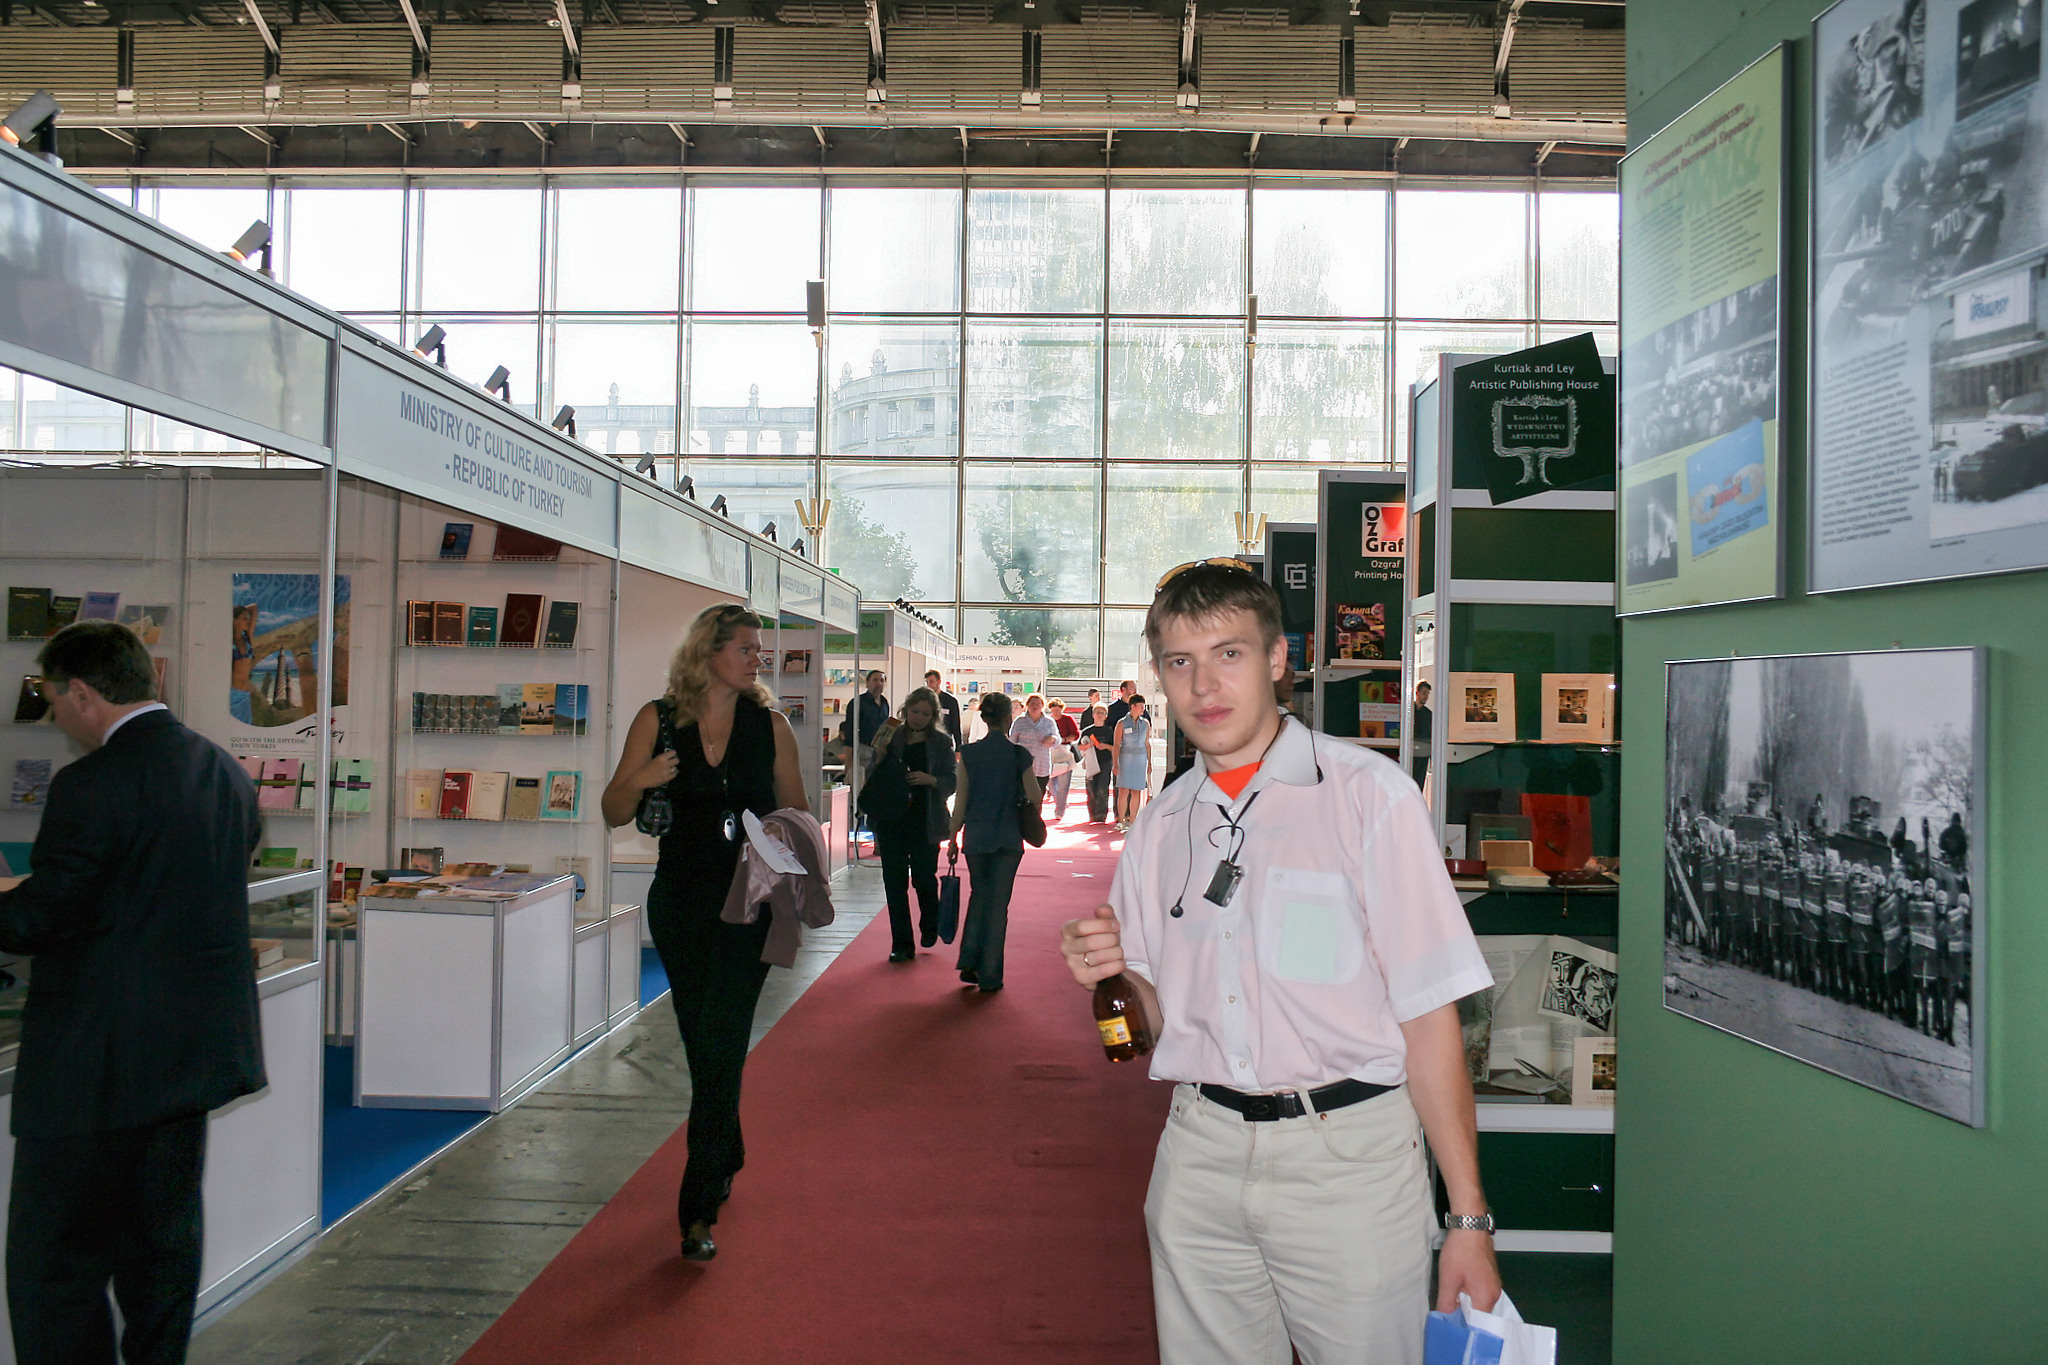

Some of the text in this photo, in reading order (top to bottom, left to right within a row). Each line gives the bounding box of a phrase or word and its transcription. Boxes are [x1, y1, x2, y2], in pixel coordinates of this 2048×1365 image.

[1494, 364, 1575, 375] Kurtiak and Ley
[1469, 380, 1599, 391] Artistic Publishing House
[400, 391, 592, 499] MINISTRY OF CULTURE AND TOURISM
[453, 454, 509, 498] REPUBLIC
[512, 478, 526, 502] OF
[528, 484, 565, 518] TURKEY
[1370, 560, 1401, 570] Ozgraf
[1354, 570, 1404, 581] Printing Ho
